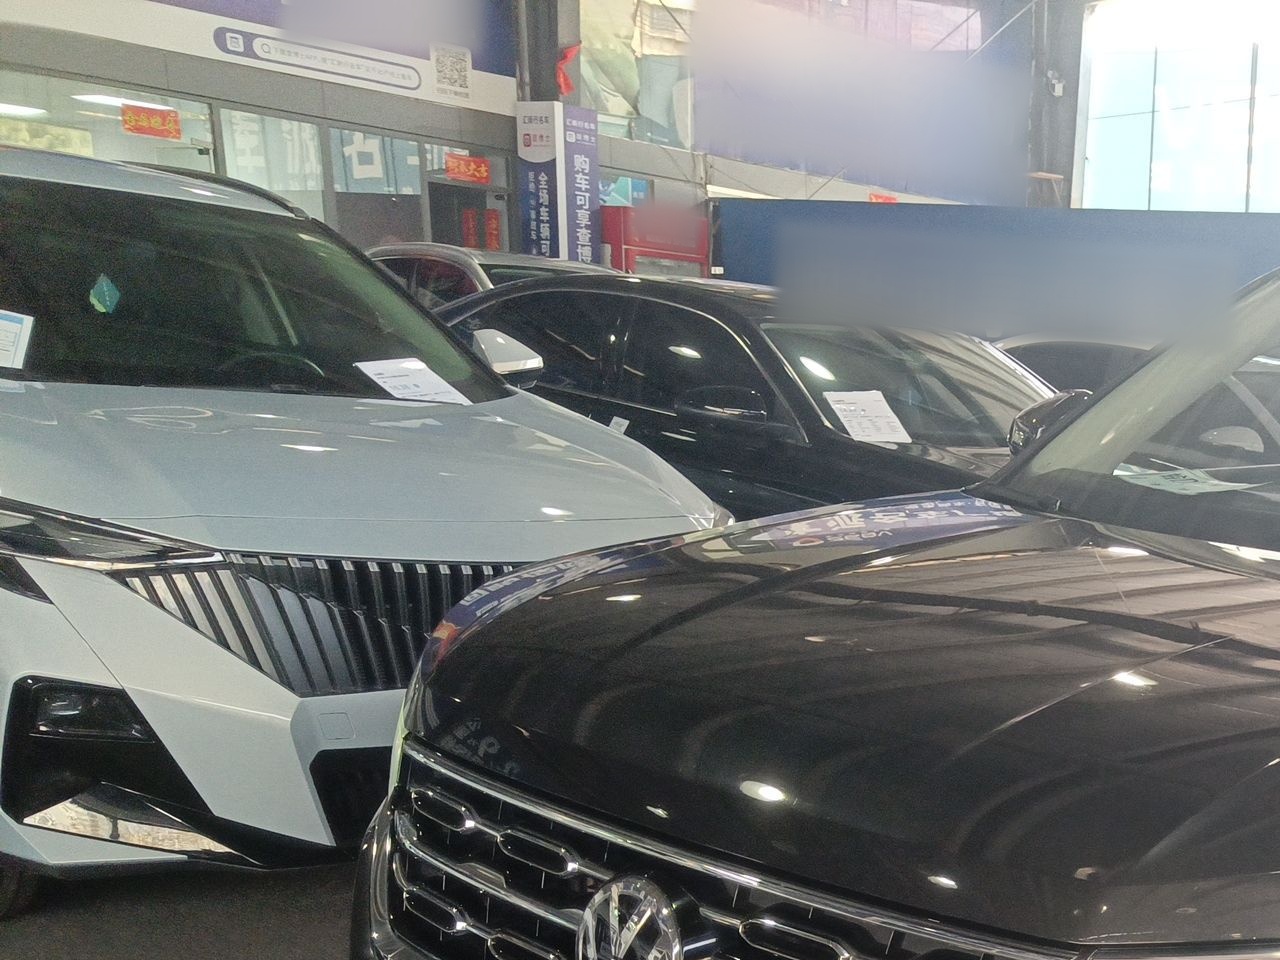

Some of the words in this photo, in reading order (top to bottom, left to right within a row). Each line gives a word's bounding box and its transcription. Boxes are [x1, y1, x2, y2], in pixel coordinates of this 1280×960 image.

[573, 154, 593, 263] 购车可享查博
